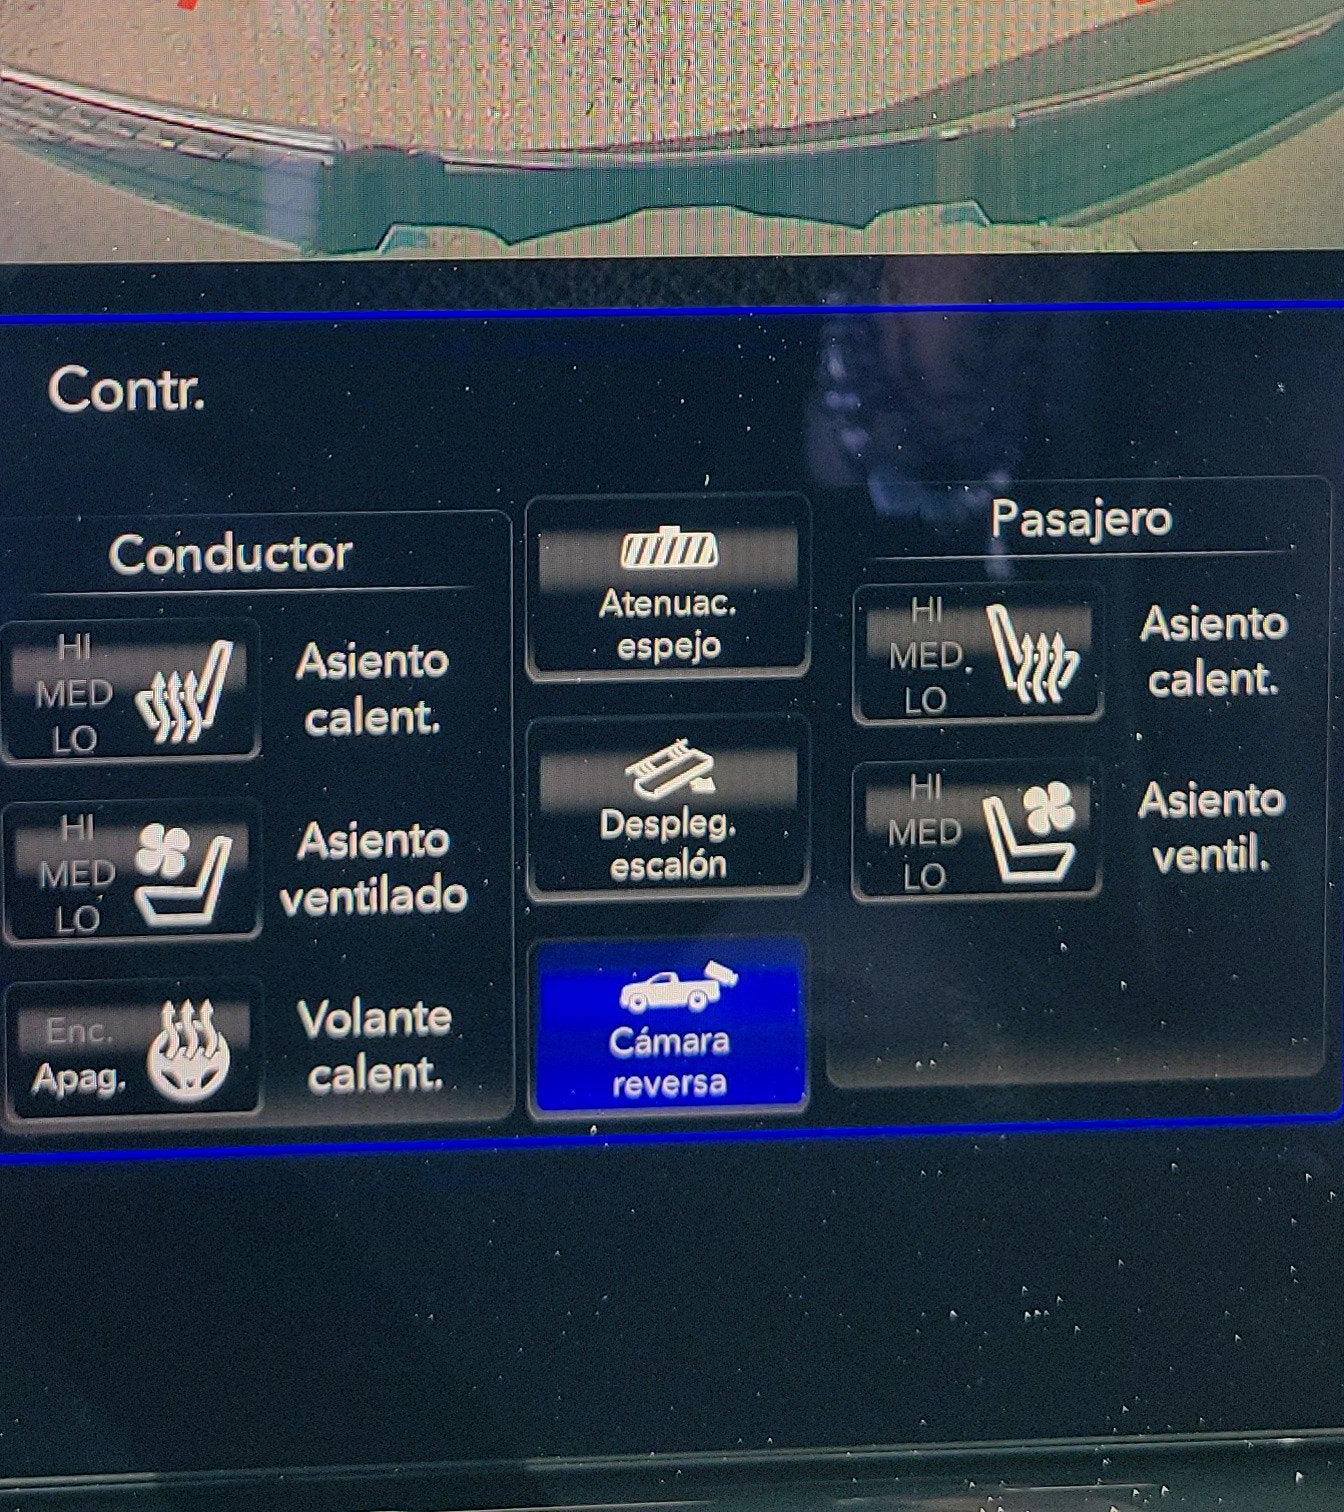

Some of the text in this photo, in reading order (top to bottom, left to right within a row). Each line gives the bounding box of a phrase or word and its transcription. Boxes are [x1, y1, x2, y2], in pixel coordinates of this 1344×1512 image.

[47, 364, 207, 414] Contr.
[990, 496, 1174, 546] Pasajero
[107, 530, 355, 577] Conductor
[598, 587, 738, 621] Atenuac.
[909, 595, 944, 625] HI
[1139, 602, 1290, 642] Asiento
[57, 632, 92, 662] HI
[295, 640, 451, 682] Asiento
[617, 629, 723, 665] espejo
[887, 639, 964, 670] MED
[35, 678, 115, 710] MED
[1147, 656, 1281, 698] calent.
[305, 694, 442, 738] calent.
[903, 685, 949, 716] LO
[51, 724, 99, 756] LO
[909, 773, 943, 802] HI
[1136, 780, 1287, 820] Asiento
[60, 813, 96, 842] HI
[296, 820, 451, 862] Asiento
[599, 805, 737, 845] Despleg.
[886, 818, 963, 848] MED
[609, 846, 728, 883] escalón
[1150, 830, 1271, 875] ventil.
[39, 858, 117, 890] MED
[903, 862, 947, 892] LO
[278, 872, 470, 919] ventilado
[55, 904, 102, 935] LO
[45, 1016, 115, 1046] Enc.
[296, 996, 454, 1039] Volante
[608, 1023, 731, 1061] Cámara
[30, 1062, 128, 1101] Apag.
[308, 1052, 444, 1095] calent.
[611, 1070, 729, 1099] reversa
